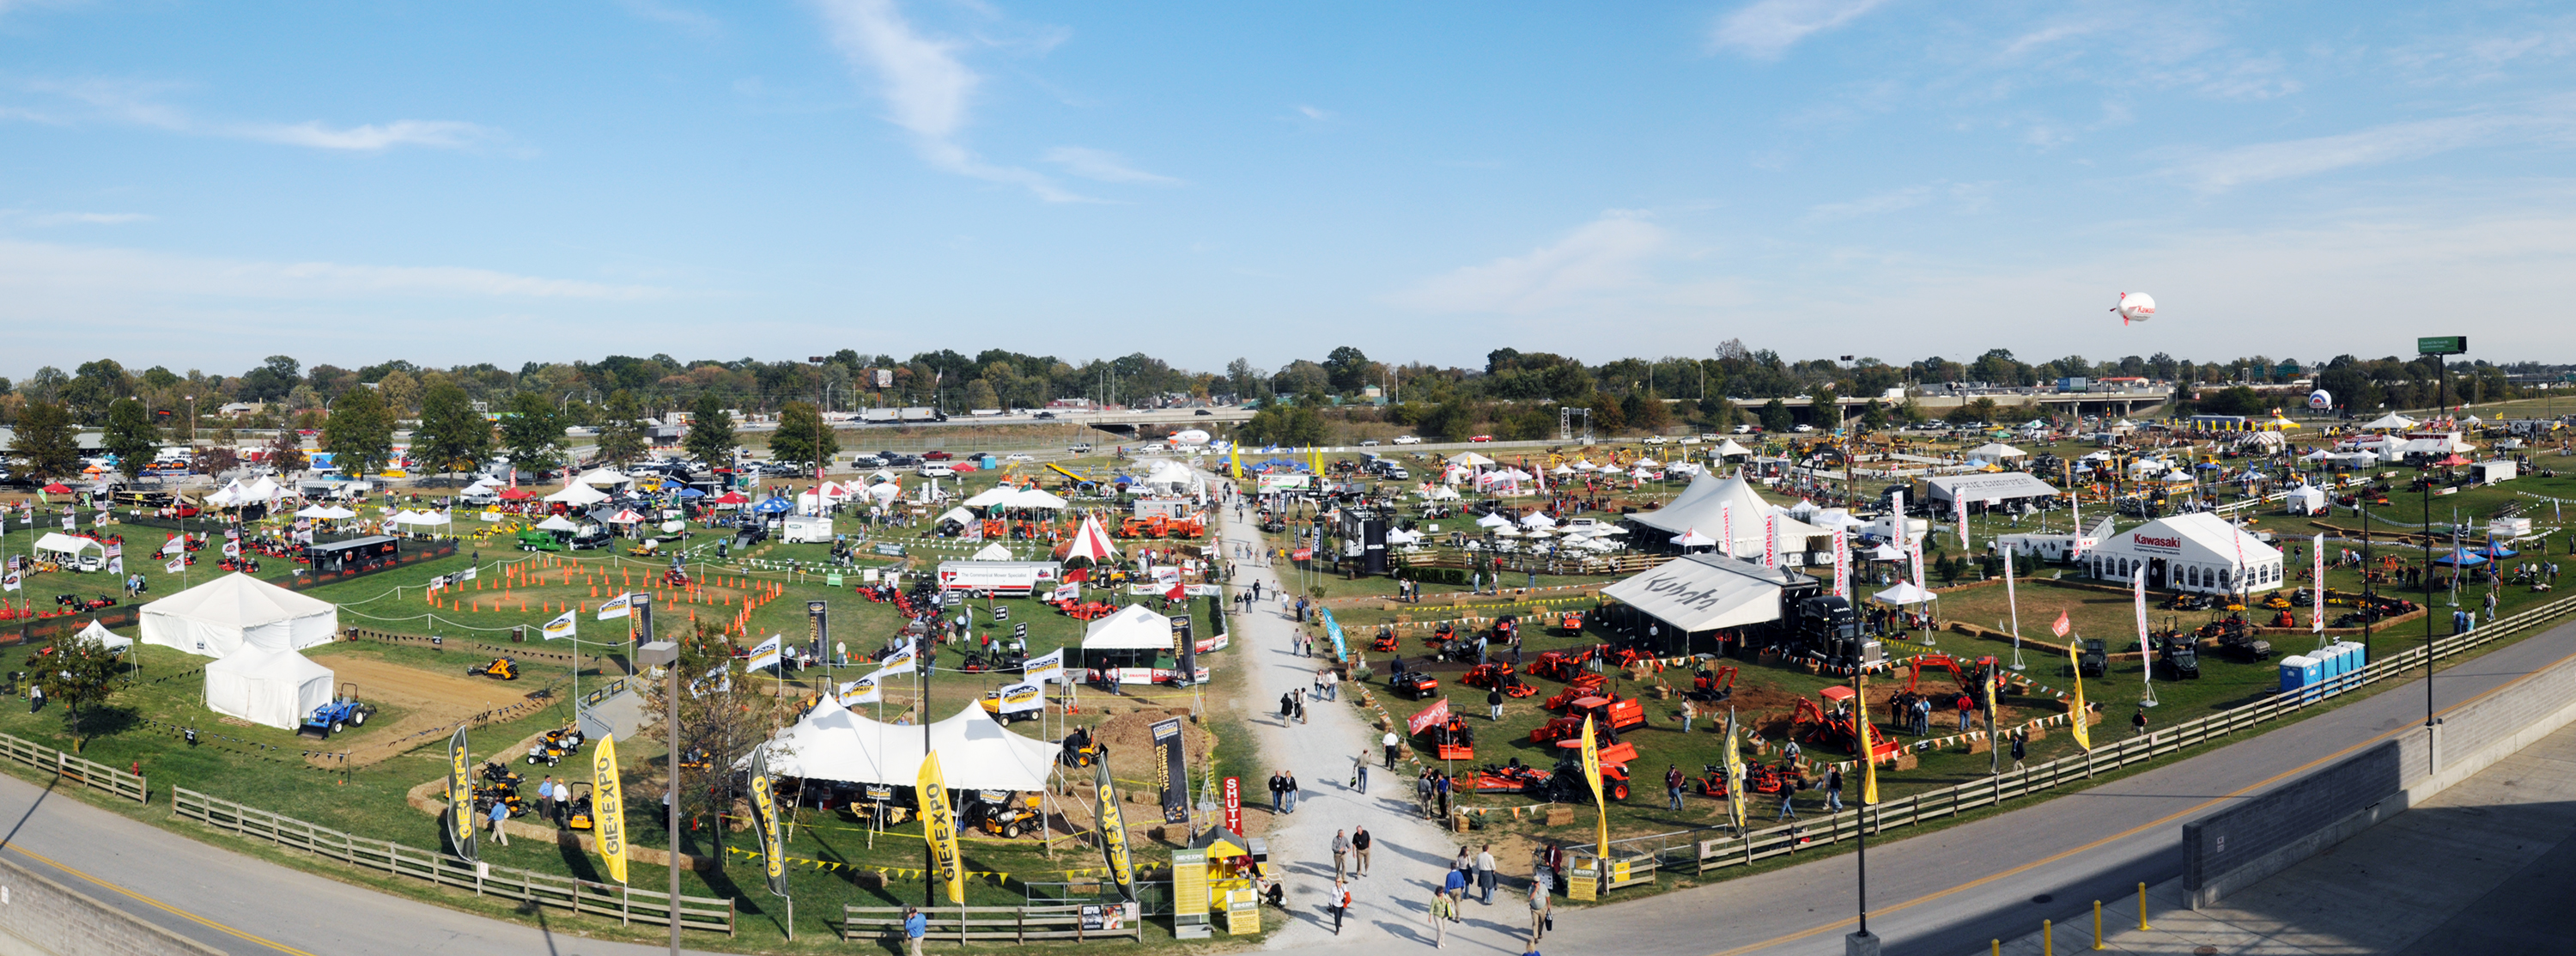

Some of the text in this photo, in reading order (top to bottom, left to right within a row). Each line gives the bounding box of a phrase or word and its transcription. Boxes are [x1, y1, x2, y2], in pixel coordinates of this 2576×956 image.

[1847, 454, 1853, 464] 7
[1983, 478, 2031, 488] CHOPPER
[1833, 529, 1844, 596] Kawasaki
[2134, 533, 2181, 548] Kawasaki
[1643, 571, 1721, 612] Kubota
[453, 746, 473, 840] GIE+EXPO
[1162, 743, 1170, 793] COMMERCIAL
[596, 756, 621, 856] GIE+EXPO
[752, 775, 783, 878] GIE+EXPO
[925, 782, 957, 883] GIE+EXPO
[1099, 783, 1132, 886] GIE+EXPO
